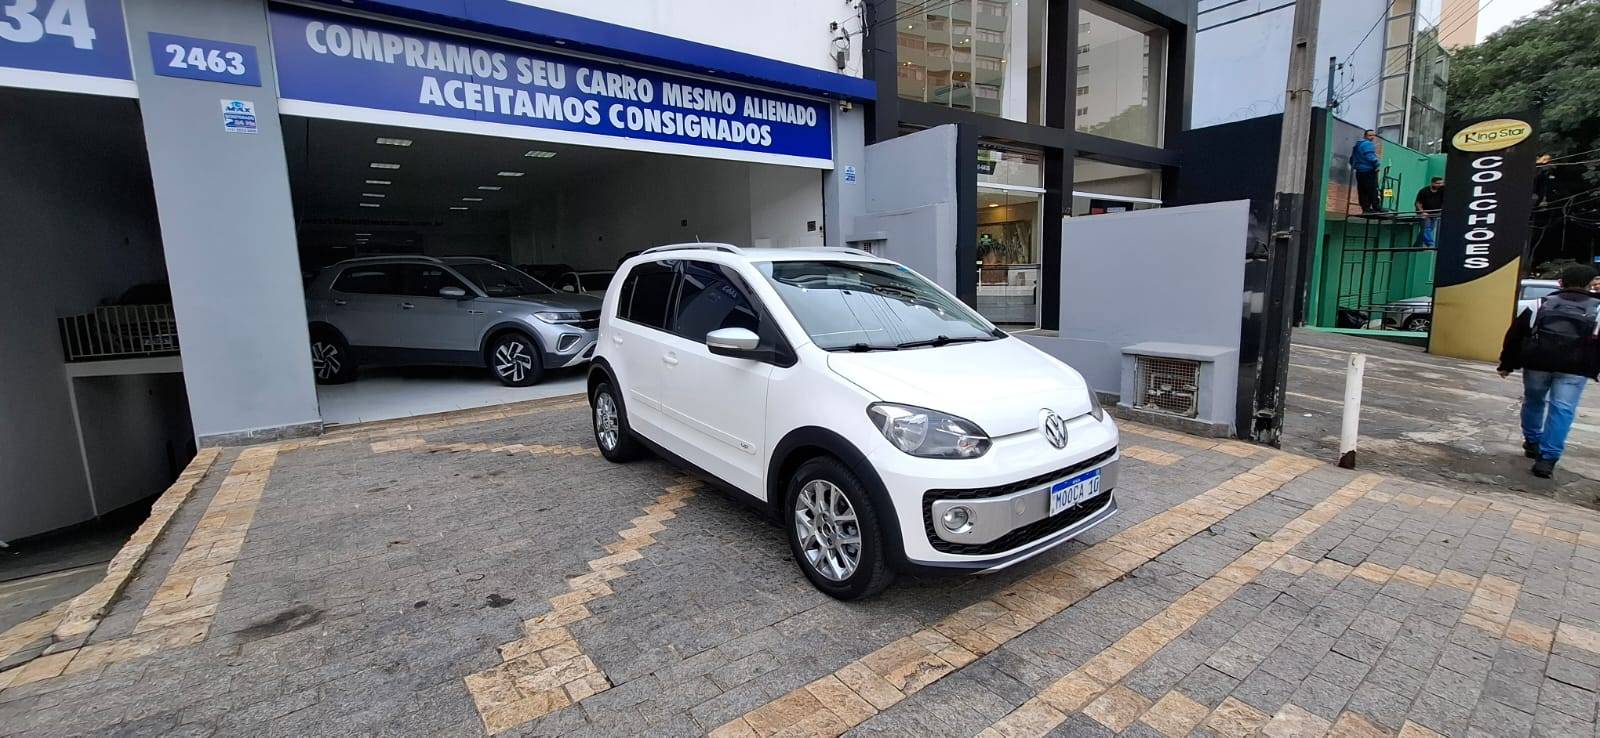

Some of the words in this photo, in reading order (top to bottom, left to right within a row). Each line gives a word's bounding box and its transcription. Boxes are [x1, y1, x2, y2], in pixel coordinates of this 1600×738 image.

[0, 0, 96, 50] 34
[165, 43, 246, 76] 2463
[306, 21, 508, 81] COMPRAMOS
[517, 56, 566, 90] SEU
[575, 66, 654, 103] CARRO
[662, 82, 737, 116] MESMO
[742, 95, 817, 128] ALIENADO
[419, 76, 601, 126] ACEITAMOS
[608, 103, 772, 147] CONSIGNADOS
[1464, 131, 1498, 144] King
[1500, 127, 1525, 138] Star
[1464, 156, 1503, 269] COLCHÕES
[1056, 483, 1084, 510] MOOCA
